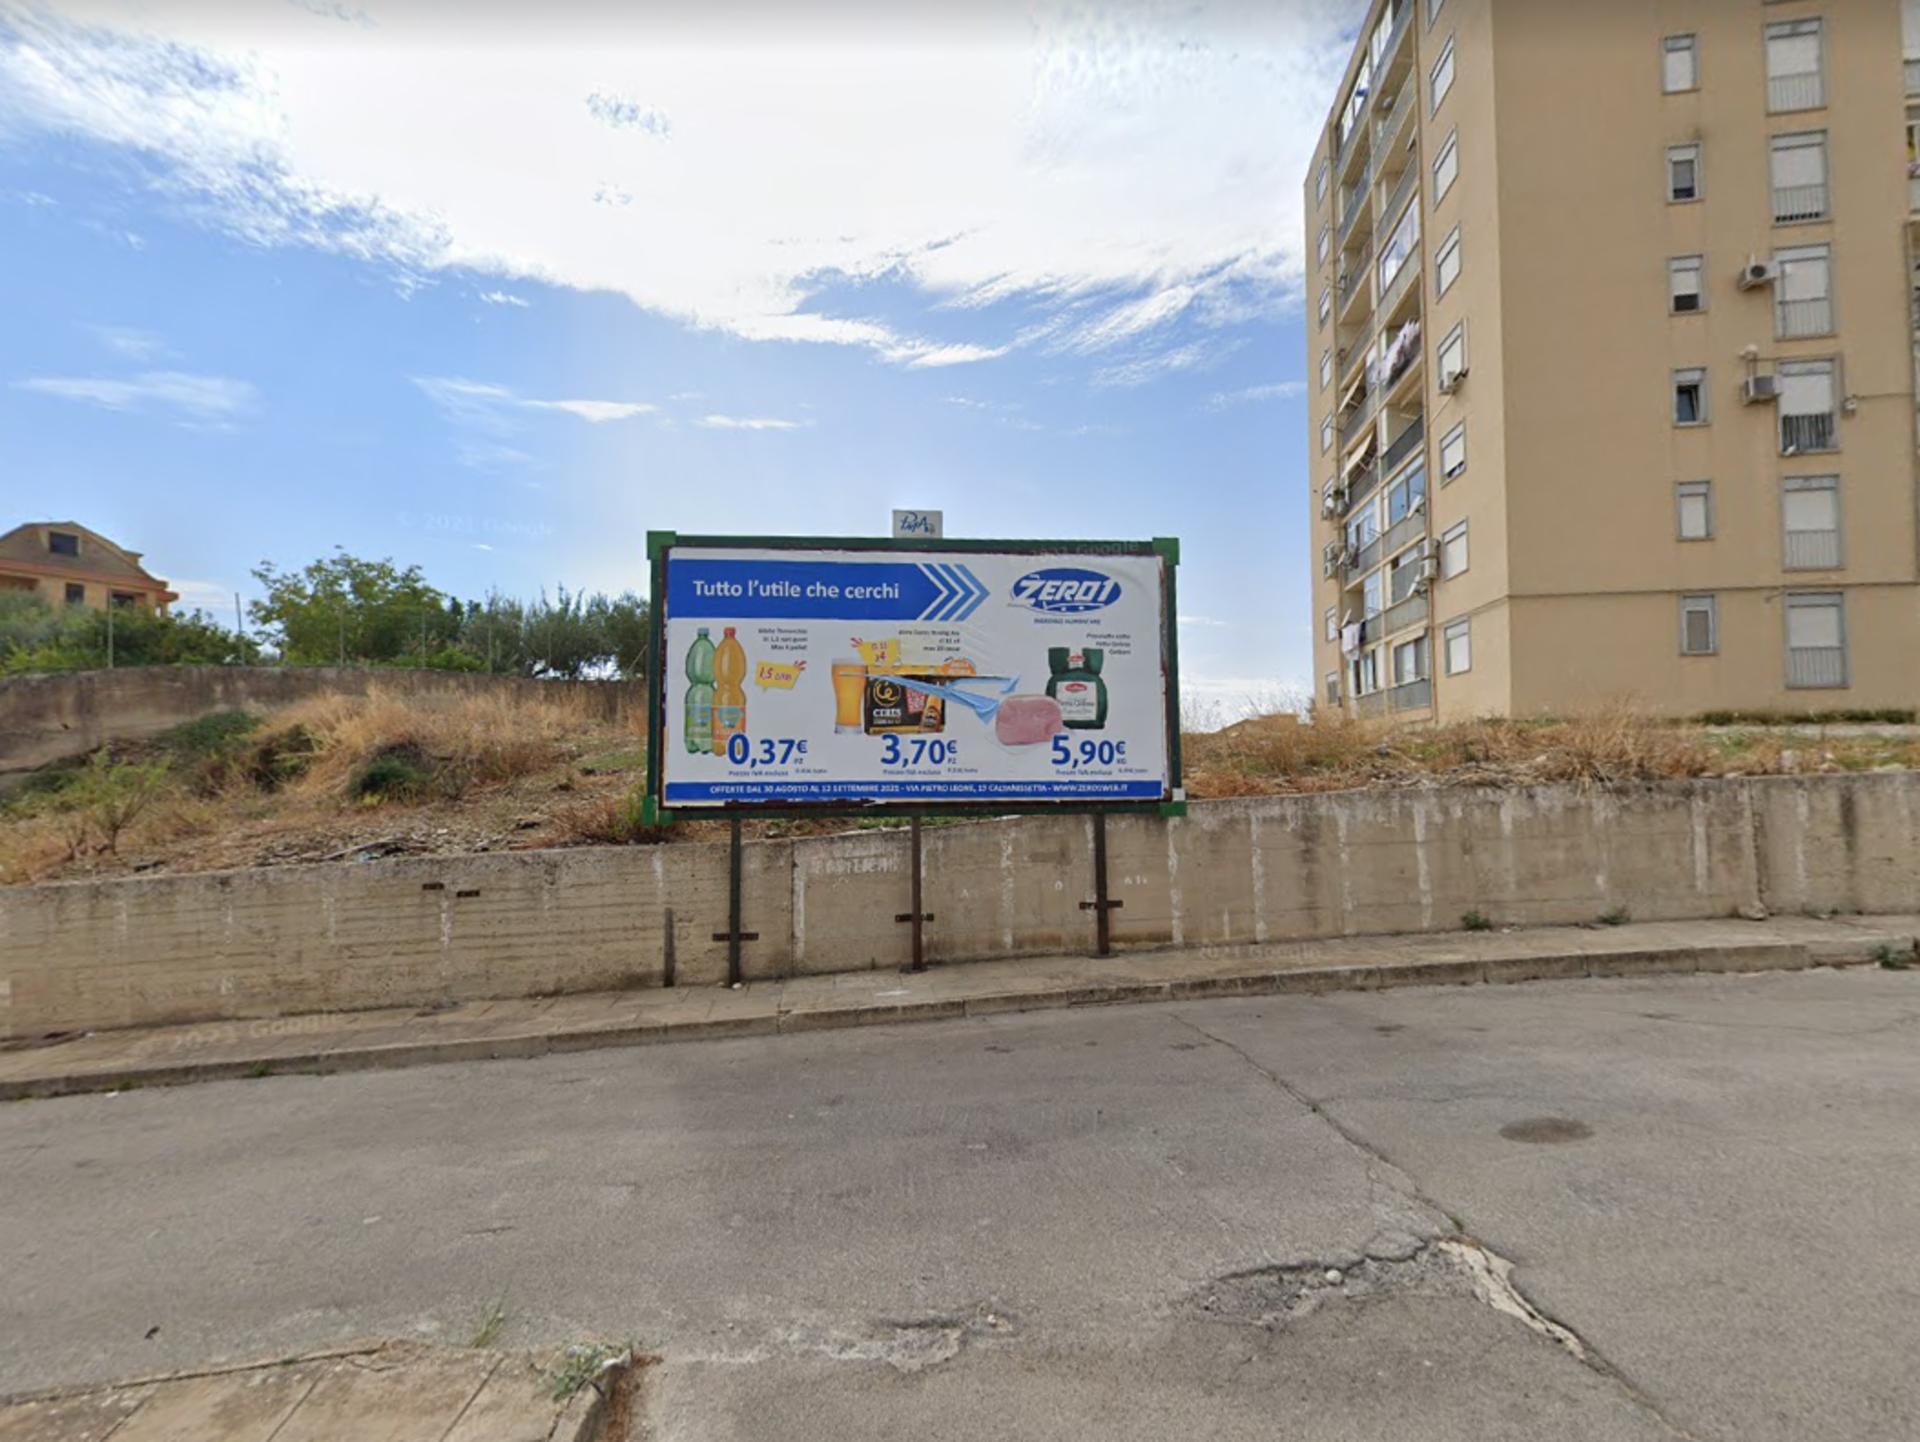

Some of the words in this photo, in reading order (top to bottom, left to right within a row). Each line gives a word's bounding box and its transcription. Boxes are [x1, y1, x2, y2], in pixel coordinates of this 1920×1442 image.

[693, 580, 742, 597] Tutto
[806, 581, 839, 599] che
[844, 582, 900, 599] cerchi
[710, 785, 745, 794] OFFERTE
[746, 785, 762, 794] DAL
[775, 785, 808, 793] AGOSTO
